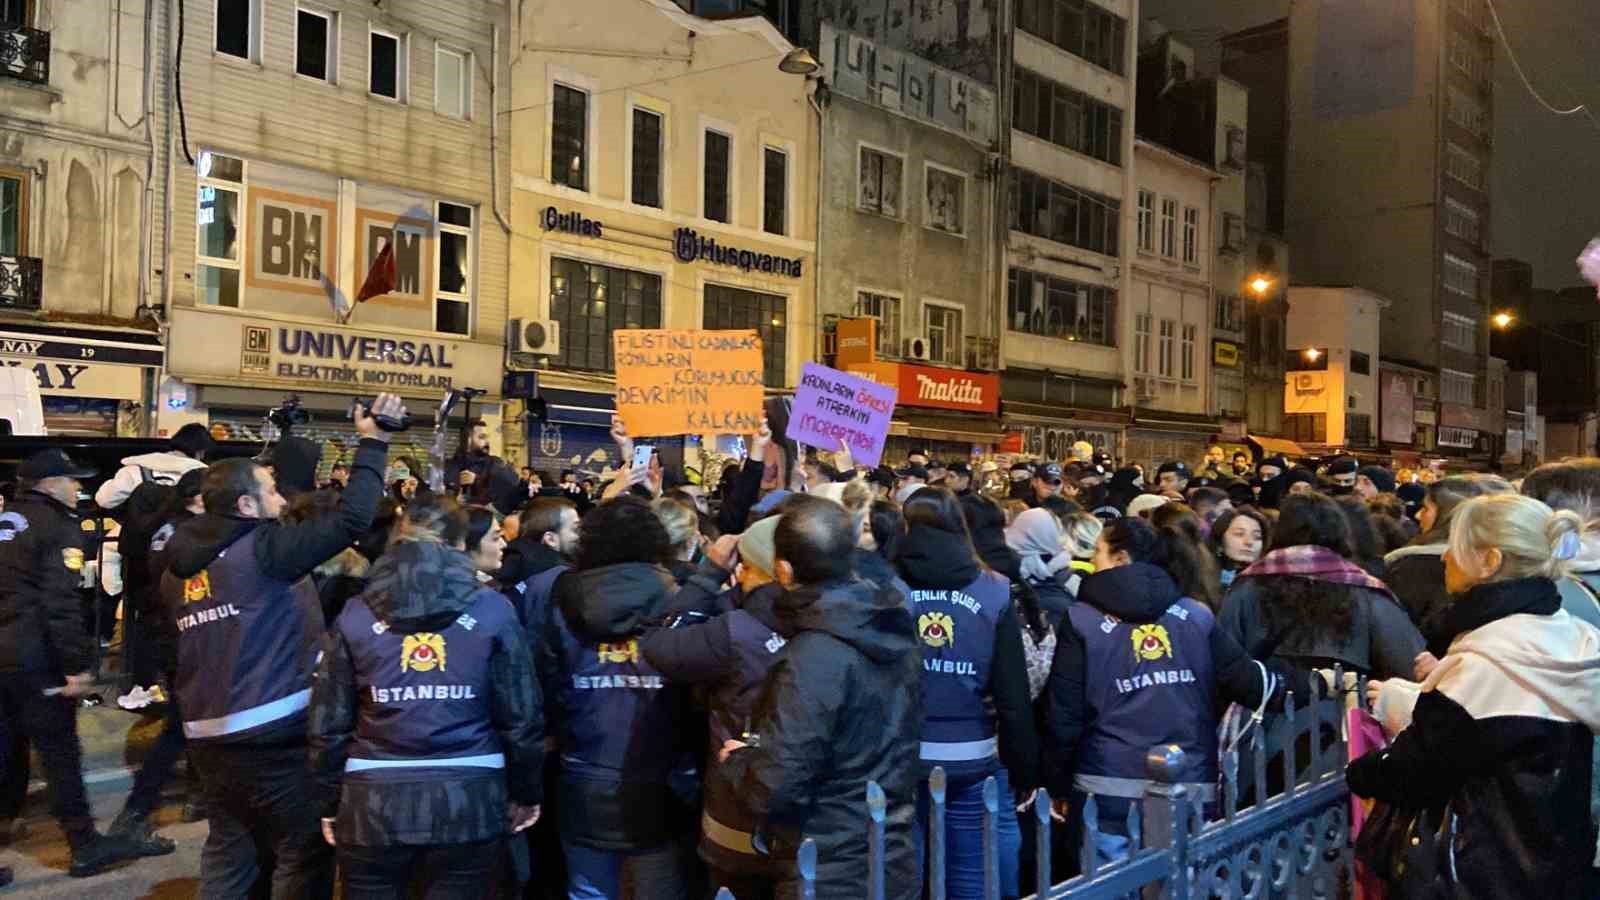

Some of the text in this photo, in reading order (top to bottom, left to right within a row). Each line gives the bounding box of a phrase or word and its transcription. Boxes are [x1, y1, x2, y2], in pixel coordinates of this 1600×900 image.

[261, 204, 323, 281] BM
[700, 235, 802, 278] Husqvarna
[0, 341, 45, 353] NAY
[80, 348, 95, 357] 19
[277, 328, 453, 369] UNIVERSAL
[278, 362, 359, 383] ELEKTRİK
[371, 685, 476, 703] İSTANBUL
